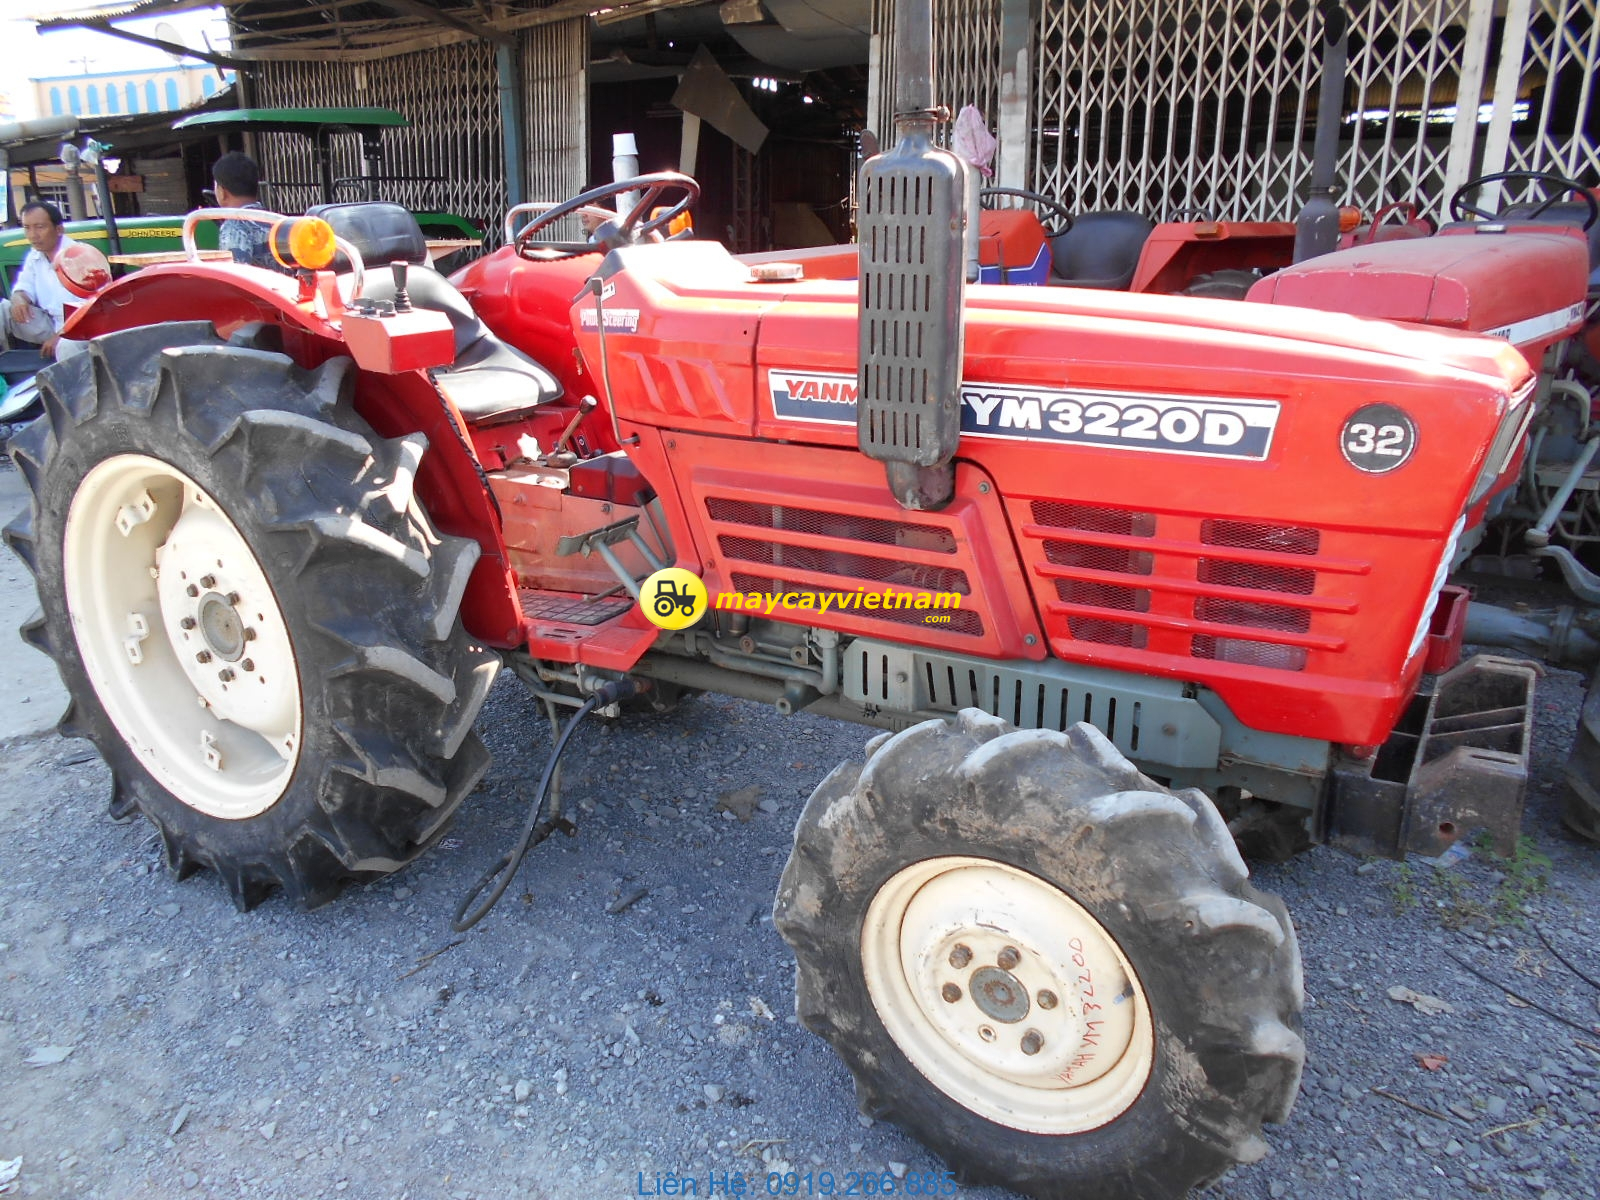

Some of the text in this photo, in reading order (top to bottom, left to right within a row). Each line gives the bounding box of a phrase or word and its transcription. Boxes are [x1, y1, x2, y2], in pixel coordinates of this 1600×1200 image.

[785, 379, 859, 403] YANM
[964, 393, 1247, 447] YM3220D
[1347, 422, 1405, 457] 32
